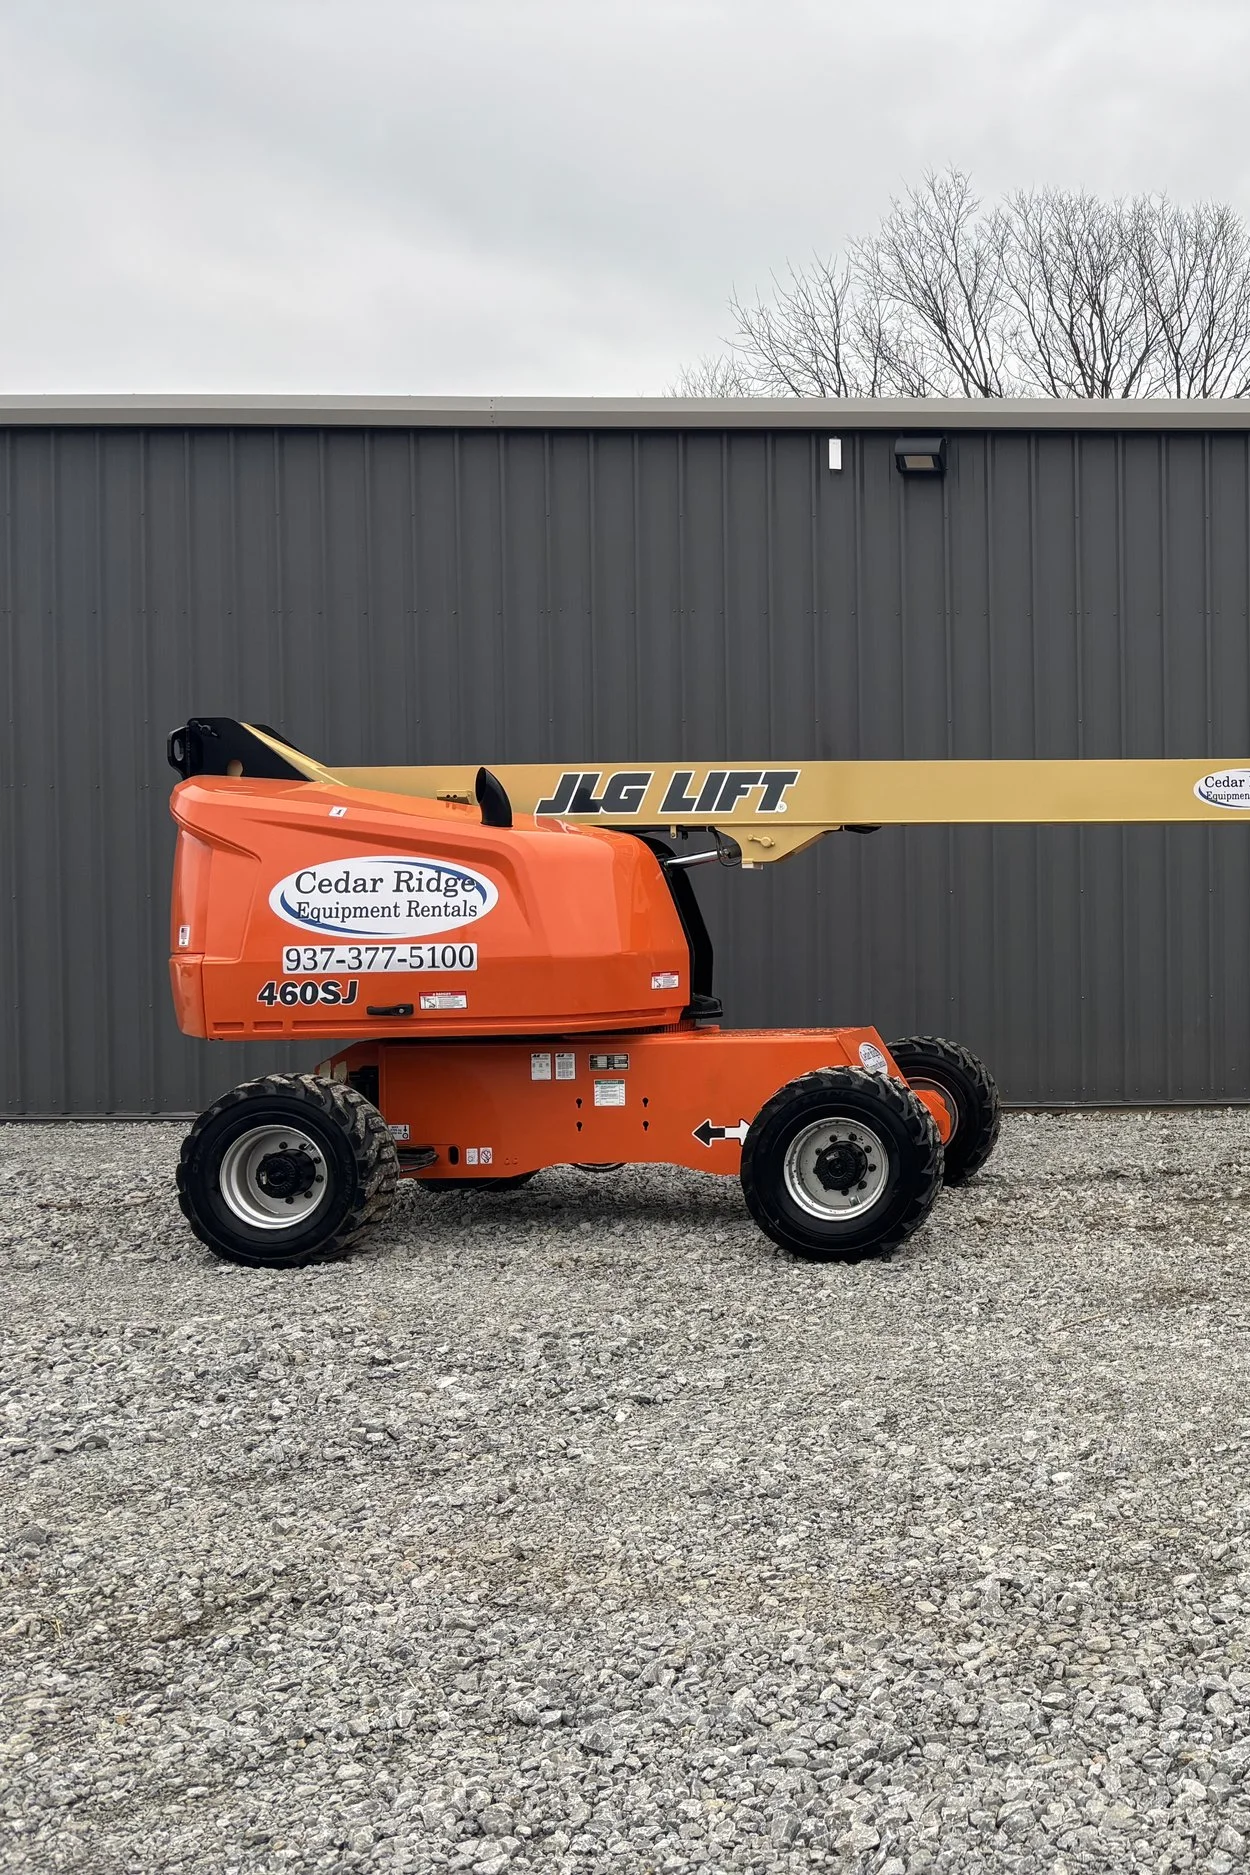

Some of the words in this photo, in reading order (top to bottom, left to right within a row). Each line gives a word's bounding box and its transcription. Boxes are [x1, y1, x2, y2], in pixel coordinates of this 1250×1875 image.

[535, 770, 655, 815] JLG
[658, 769, 801, 814] LIFT
[1204, 776, 1245, 788] Cedar
[295, 870, 384, 895] Cedar
[392, 870, 475, 898] Ridge
[296, 901, 400, 924] Equipment
[405, 899, 478, 918] Rentals
[285, 945, 475, 972] 937-377-5100
[257, 979, 359, 1007] 460SJ
